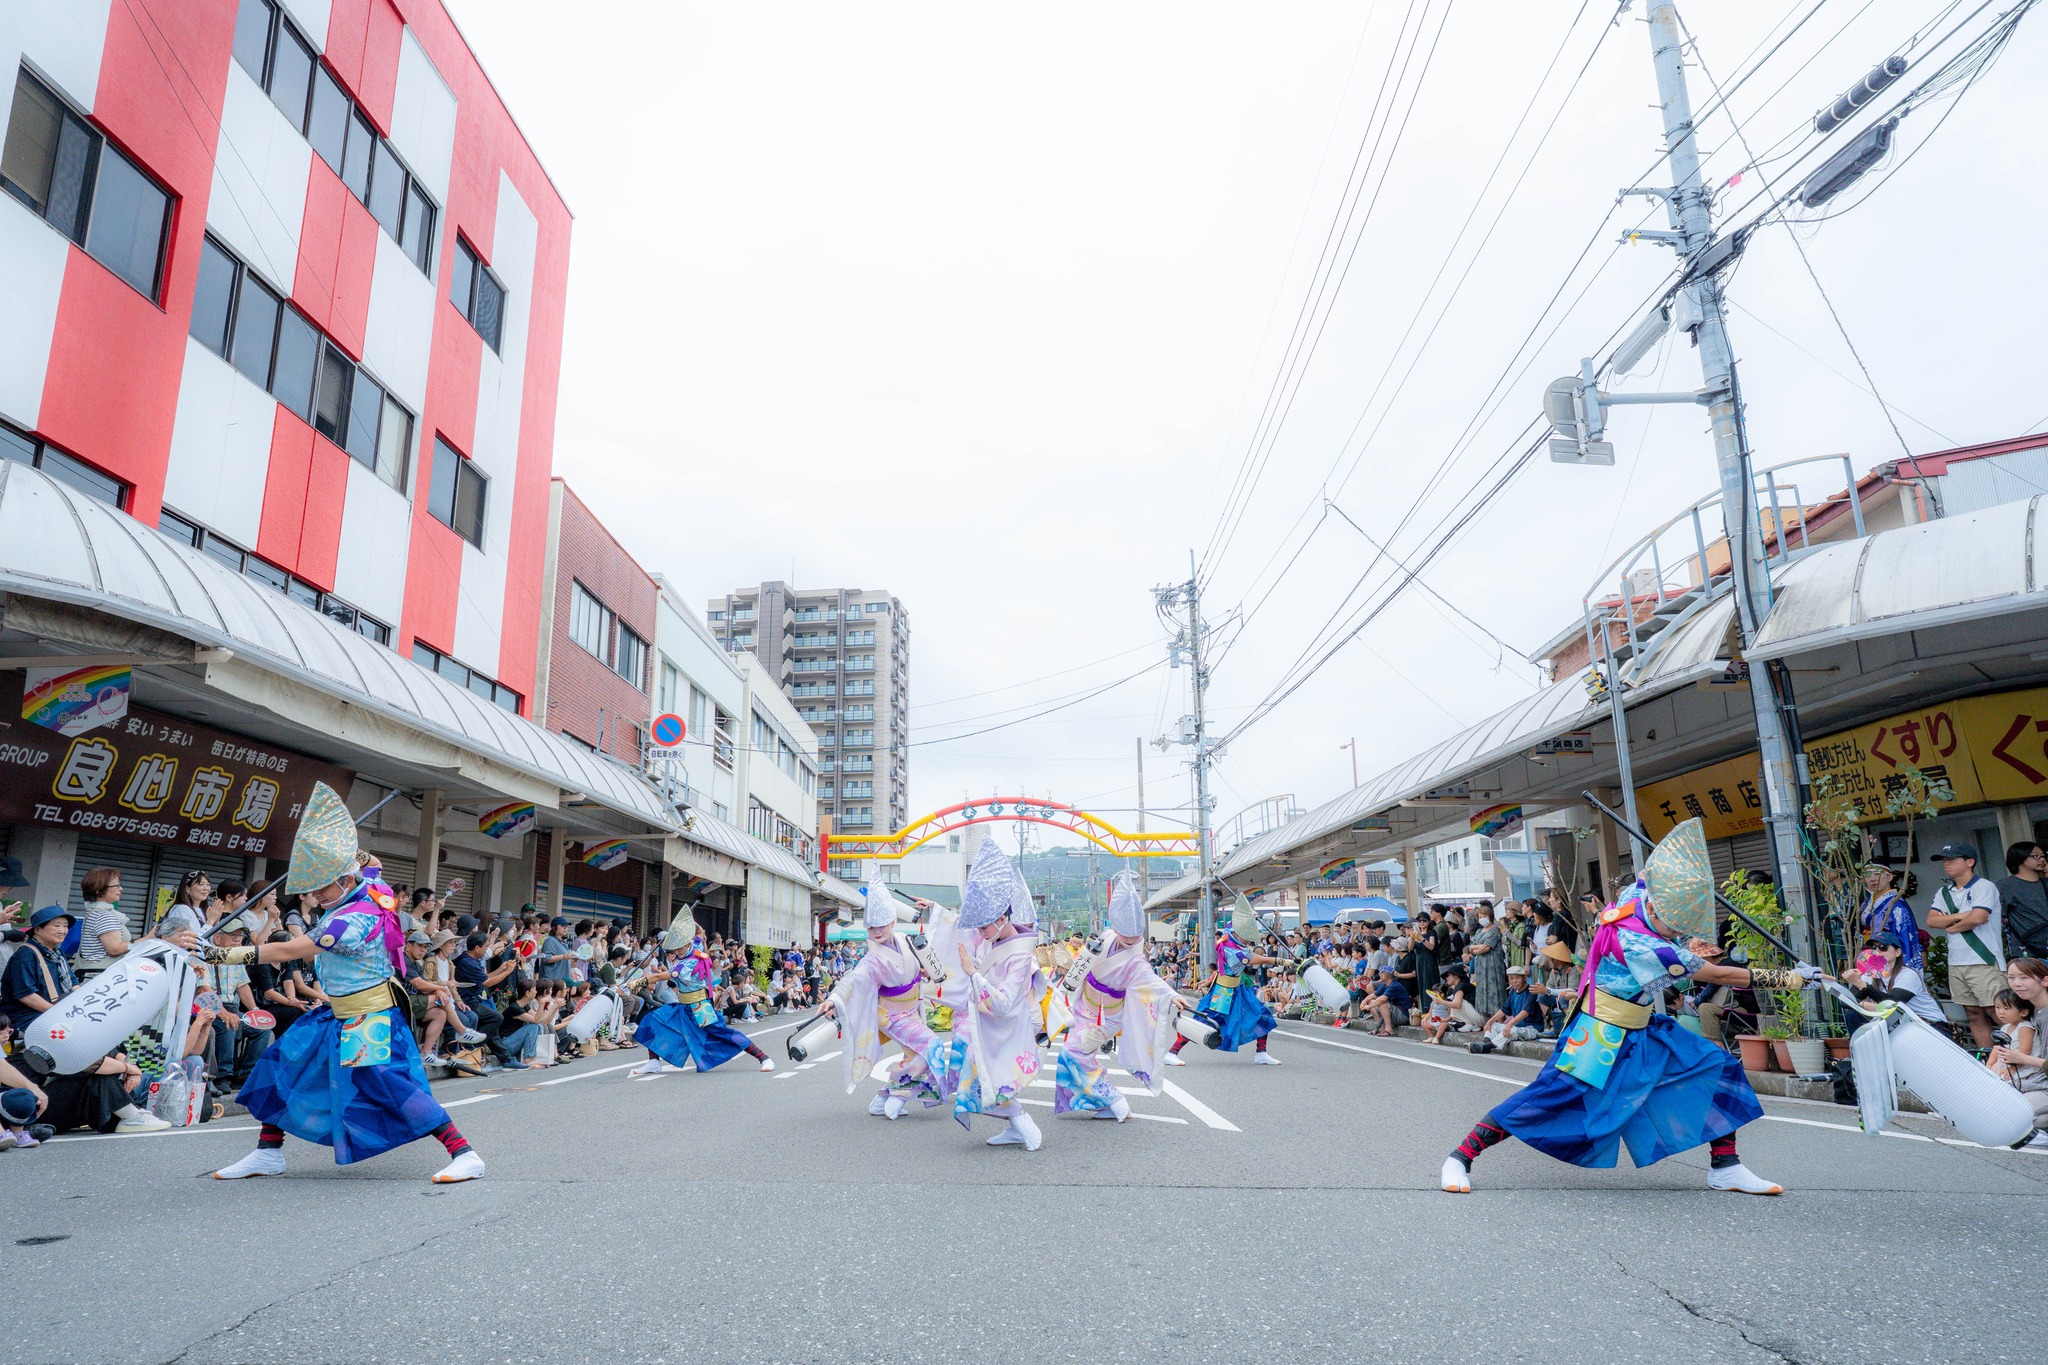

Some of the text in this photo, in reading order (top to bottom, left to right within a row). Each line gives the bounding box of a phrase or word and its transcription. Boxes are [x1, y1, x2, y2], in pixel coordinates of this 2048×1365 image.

[125, 717, 154, 736] 安い
[159, 726, 193, 746] うまい
[1871, 711, 1957, 768] くすり
[211, 740, 288, 773] 毎日が特売の店
[651, 750, 682, 759] 自転車を除く
[1991, 714, 2048, 785] く
[54, 739, 279, 832] 良心市場
[1659, 779, 1762, 826] 千頭商店
[1852, 793, 1883, 817] 受付
[34, 803, 179, 840] TEL 088-875-9656
[186, 827, 266, 853] 定休日 日・祝日
[1073, 956, 1092, 982] よんでん
